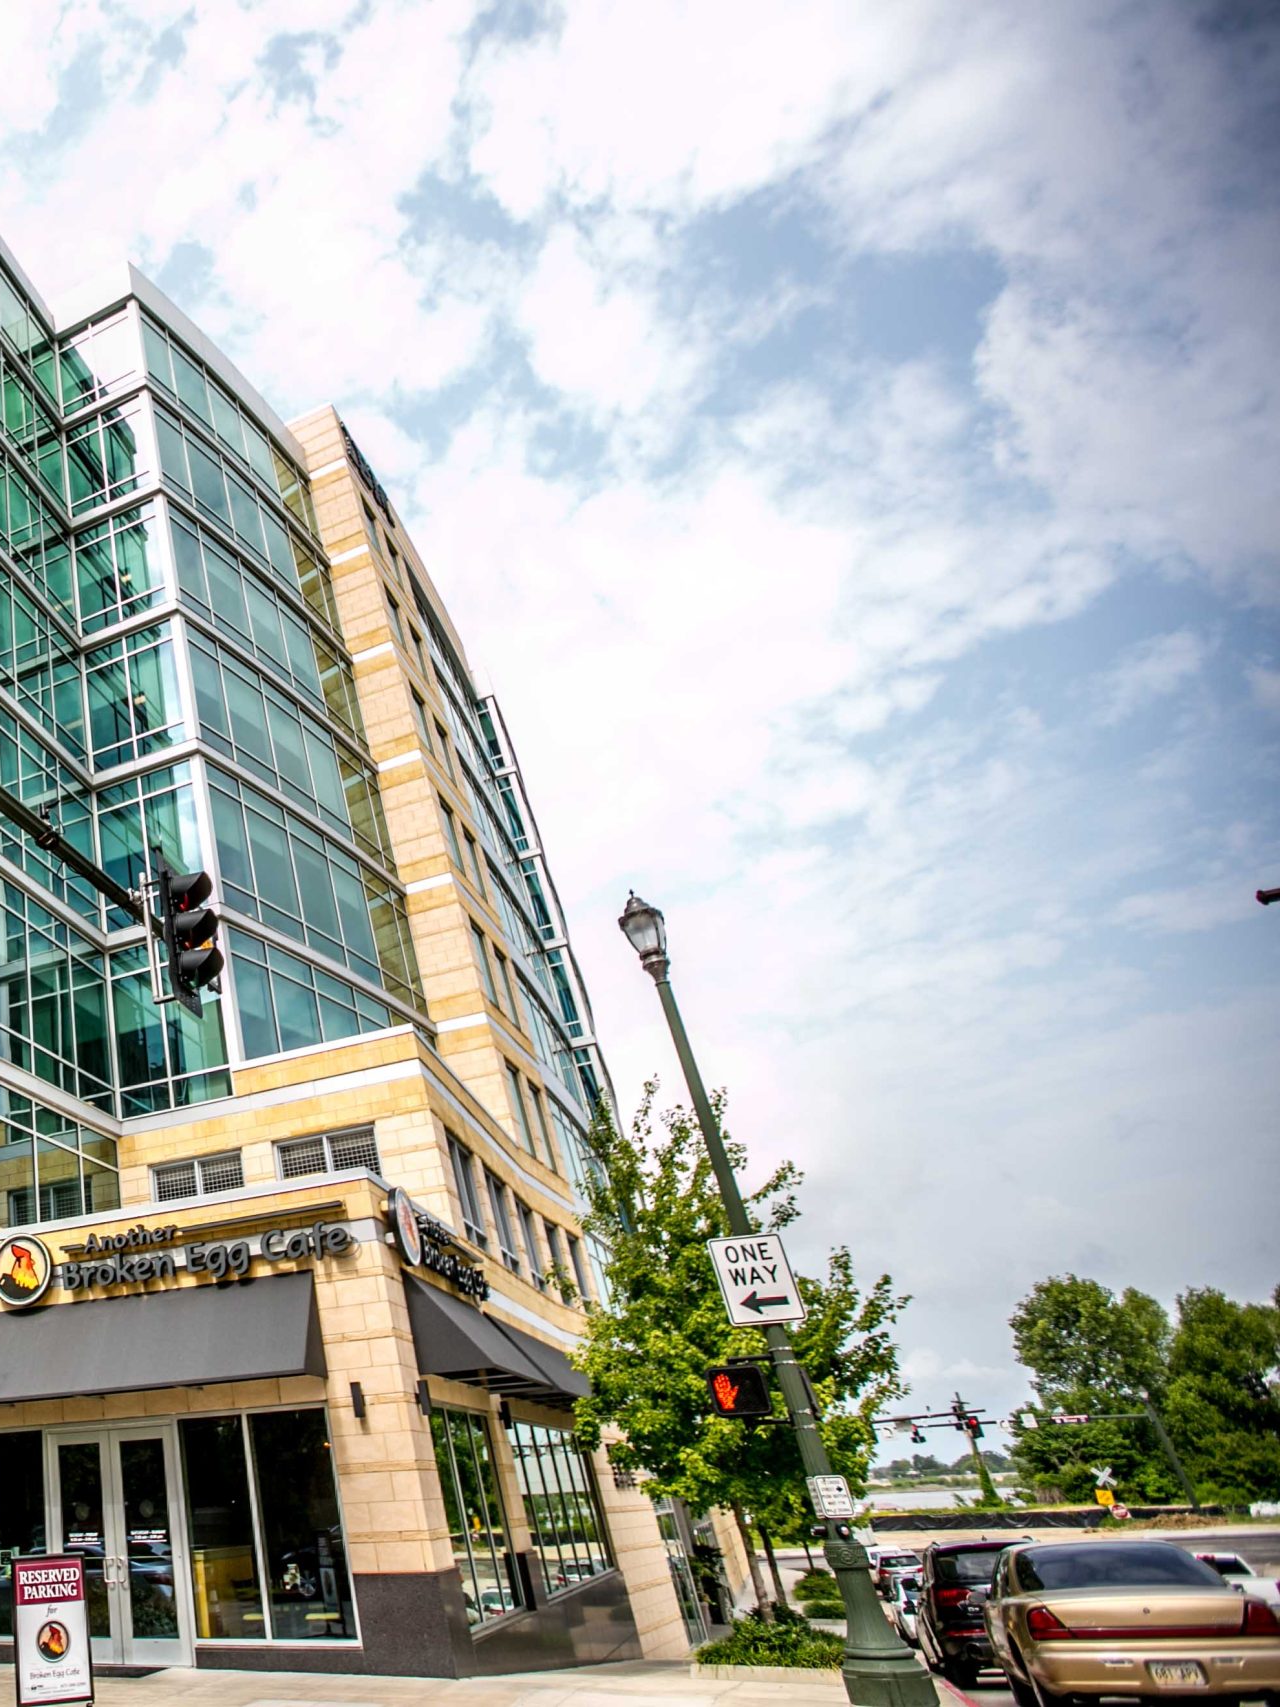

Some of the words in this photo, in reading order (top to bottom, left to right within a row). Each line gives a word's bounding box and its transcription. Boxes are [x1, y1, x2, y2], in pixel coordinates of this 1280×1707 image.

[84, 1224, 177, 1253] Another
[62, 1252, 177, 1290] Broken
[184, 1241, 251, 1278] Egg
[260, 1220, 350, 1261] Cafe
[725, 1242, 773, 1263] ONE
[728, 1264, 777, 1286] WAY
[19, 1567, 80, 1585] RESERVED
[23, 1582, 78, 1600] PARKING
[45, 1604, 58, 1617] for
